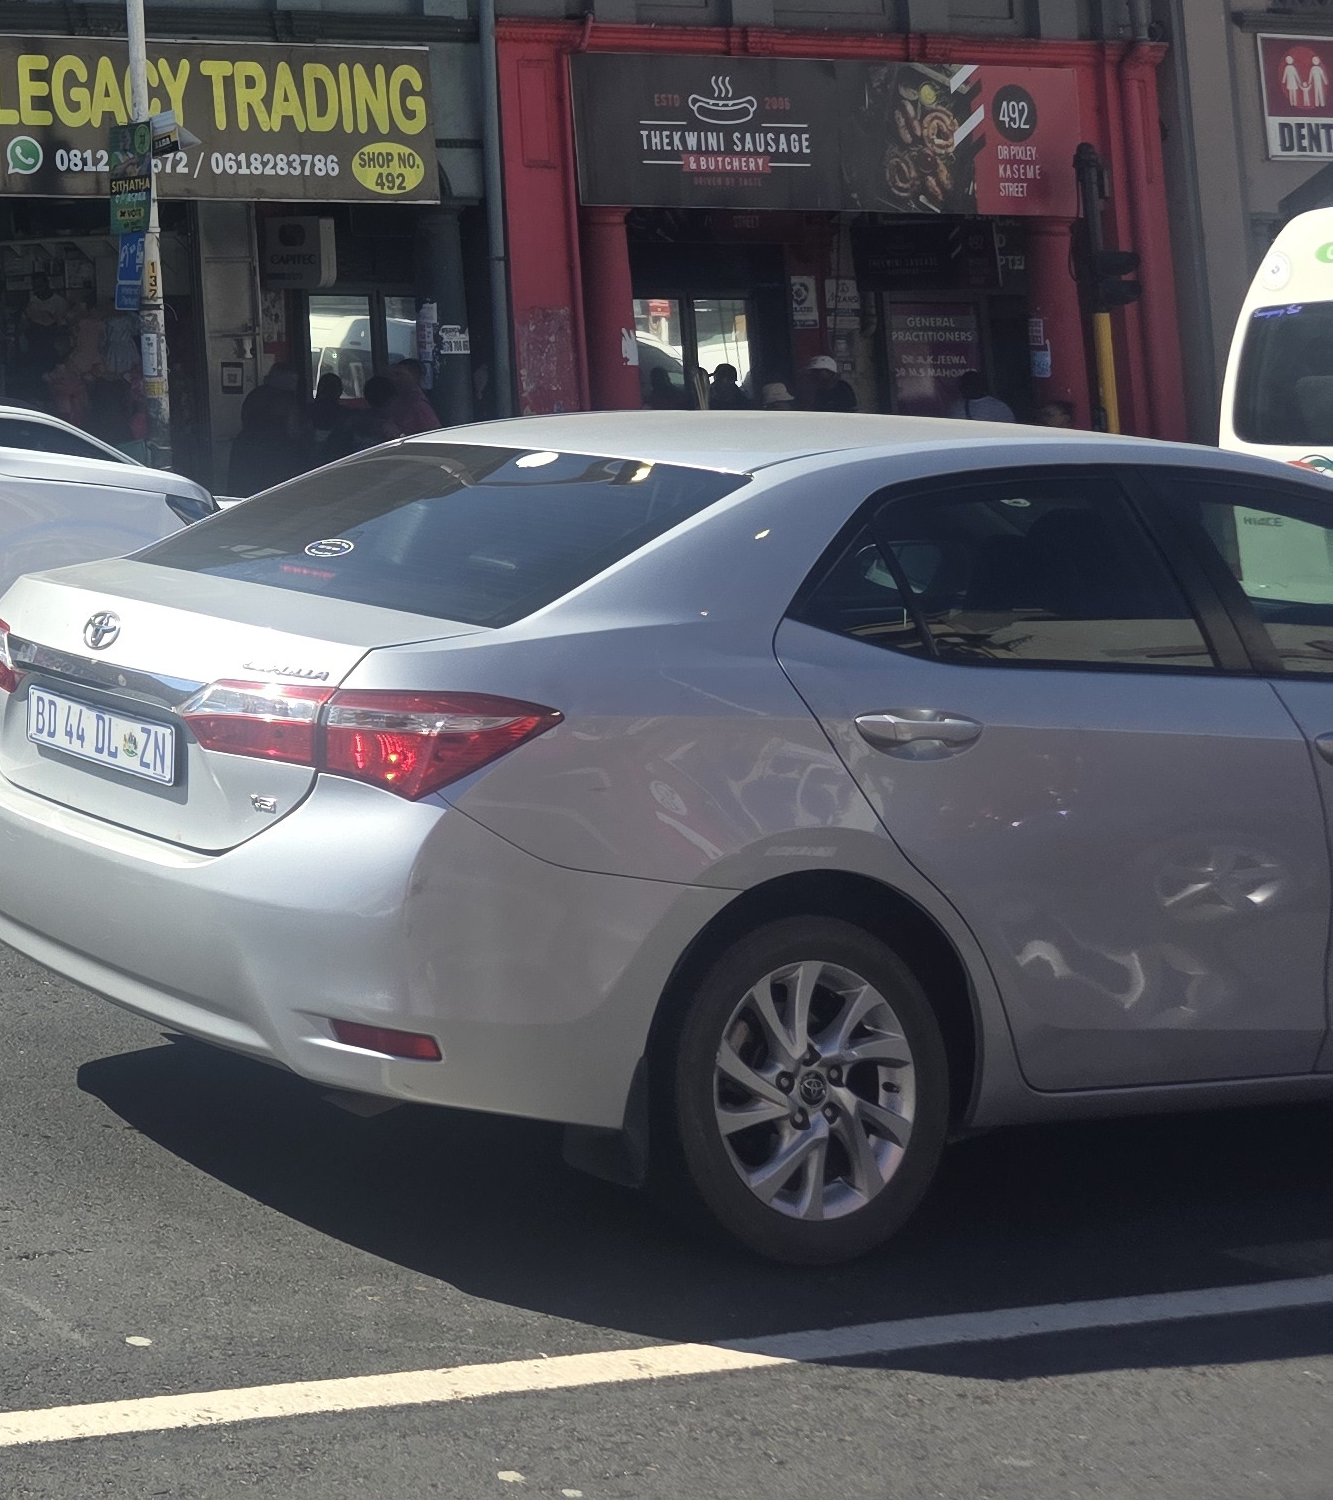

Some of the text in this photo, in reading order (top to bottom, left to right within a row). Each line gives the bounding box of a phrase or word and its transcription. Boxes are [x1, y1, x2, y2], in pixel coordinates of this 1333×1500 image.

[200, 59, 427, 136] TRADING
[999, 100, 1030, 129] 492
[640, 130, 811, 153] THEKWINI SAUSAGE
[998, 145, 1009, 160] DR
[211, 152, 339, 176] 0618283786
[358, 152, 420, 170] SHOP NO.
[689, 156, 764, 171] & BUTCHERY
[999, 164, 1041, 179] KASEME
[111, 178, 150, 193] SITHATHA
[375, 173, 407, 191] 492
[1000, 183, 1027, 197] STREET
[270, 254, 318, 266] CAPITEC
[906, 317, 956, 329] GENERAL
[892, 331, 973, 343] PRACTITIONERS
[35, 695, 166, 775] BD 44 DL ZN
